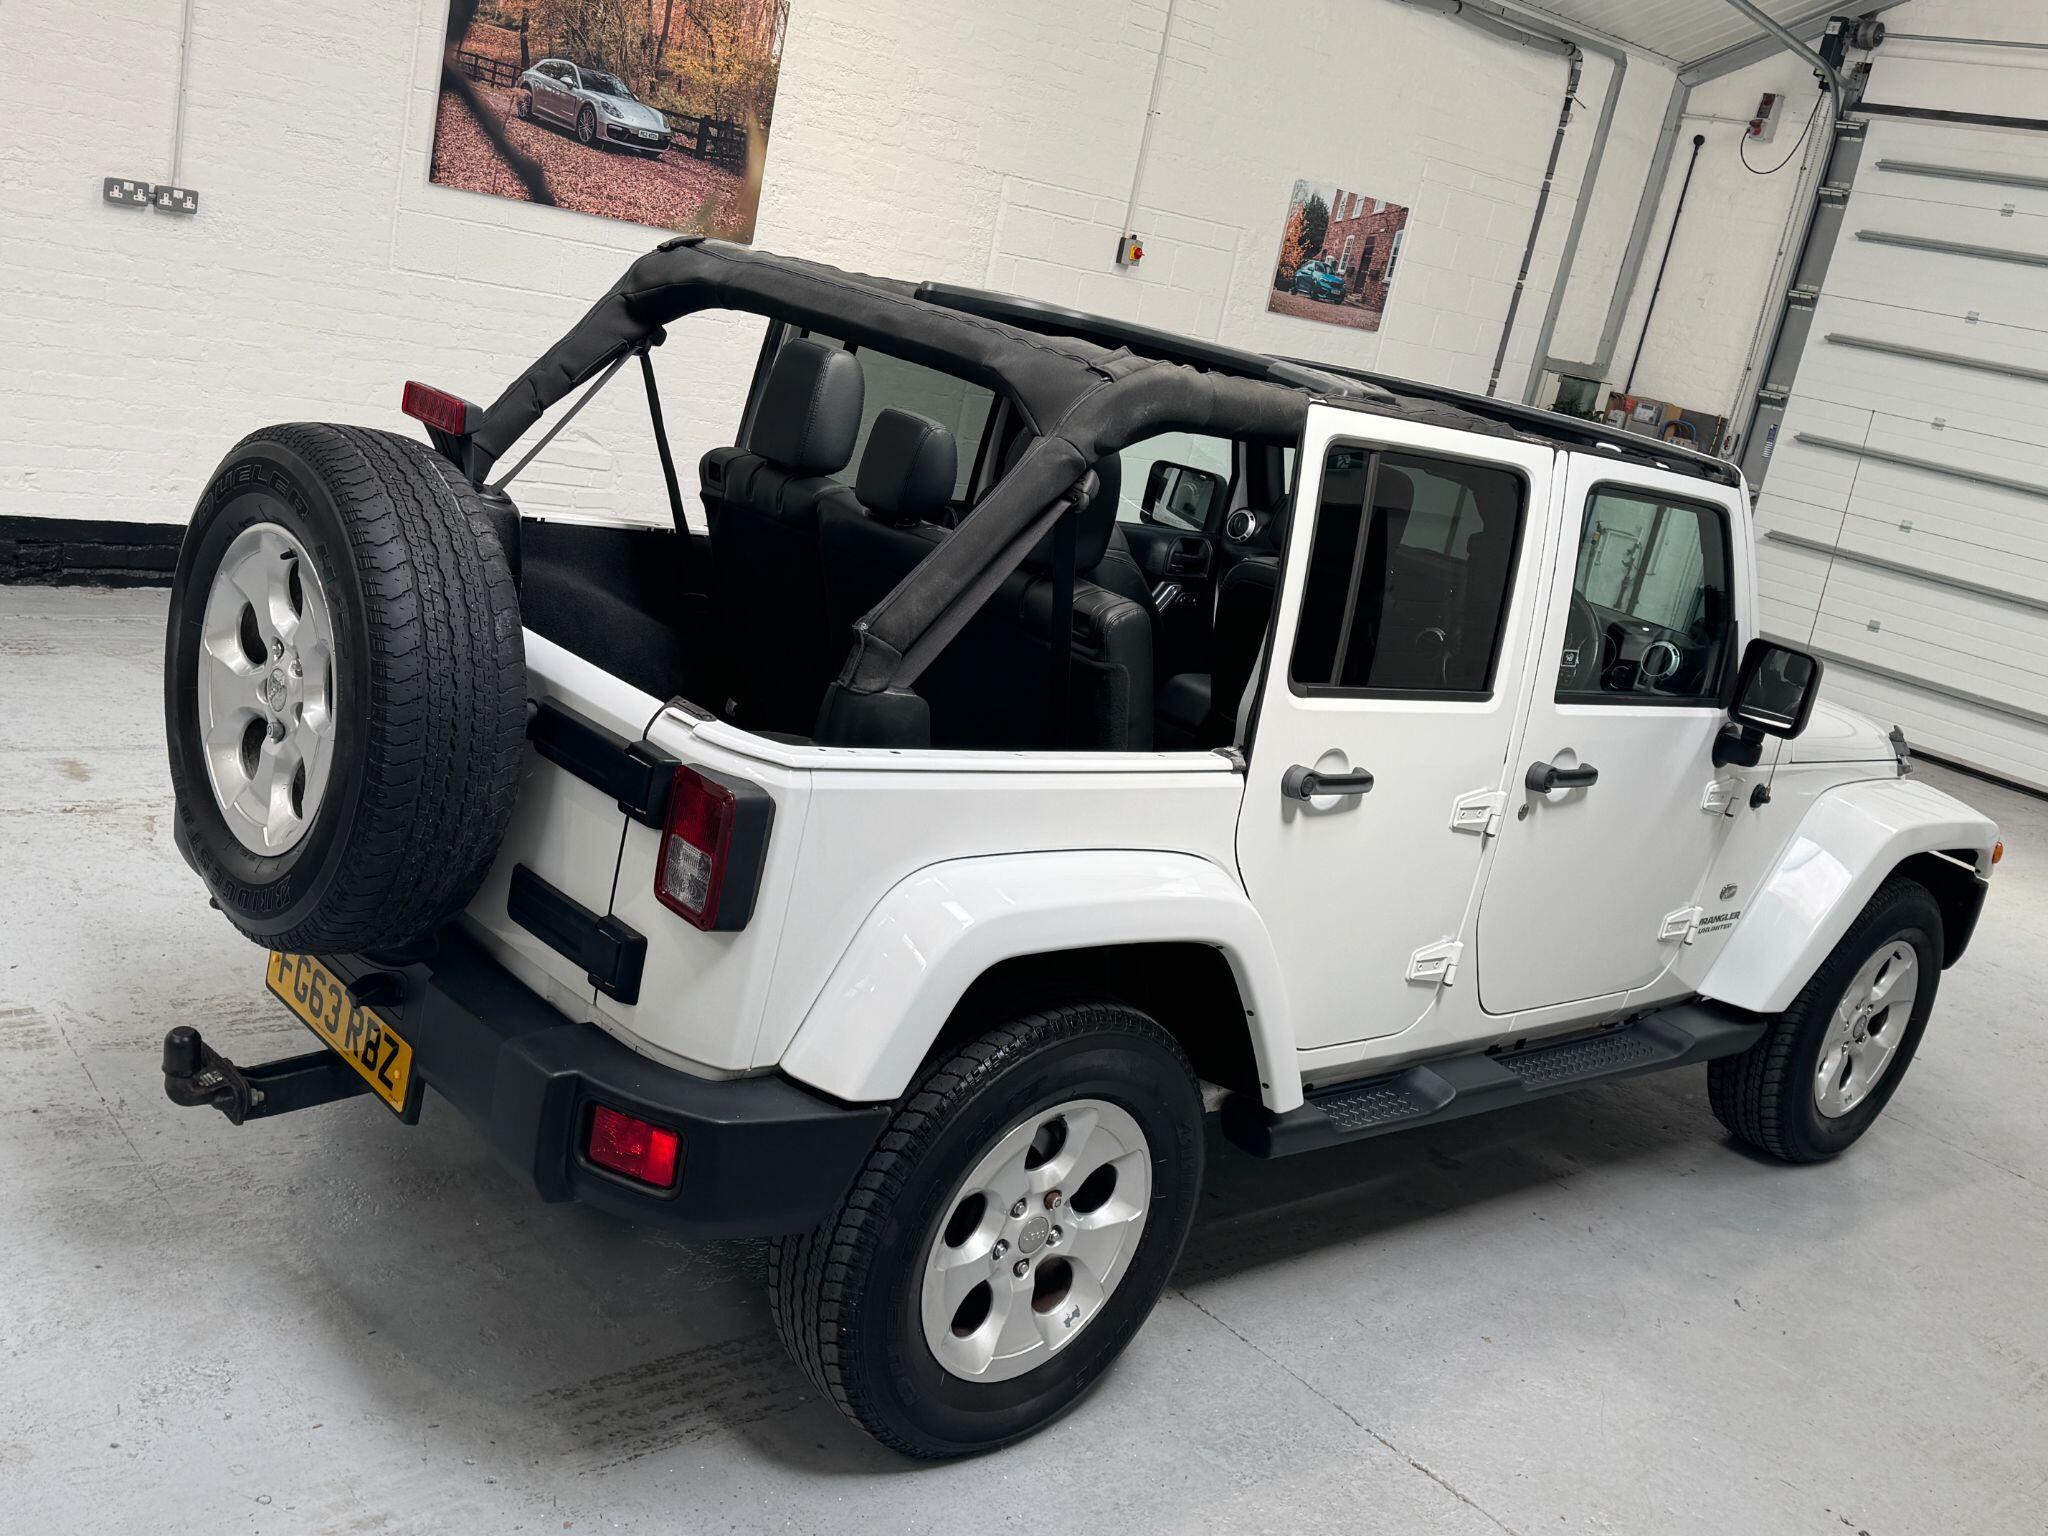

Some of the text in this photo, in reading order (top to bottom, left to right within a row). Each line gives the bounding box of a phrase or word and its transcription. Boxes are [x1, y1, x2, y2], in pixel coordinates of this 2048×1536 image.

[198, 463, 310, 527] DUELER
[278, 952, 343, 1035] FG63
[344, 1005, 400, 1092] RBZ
